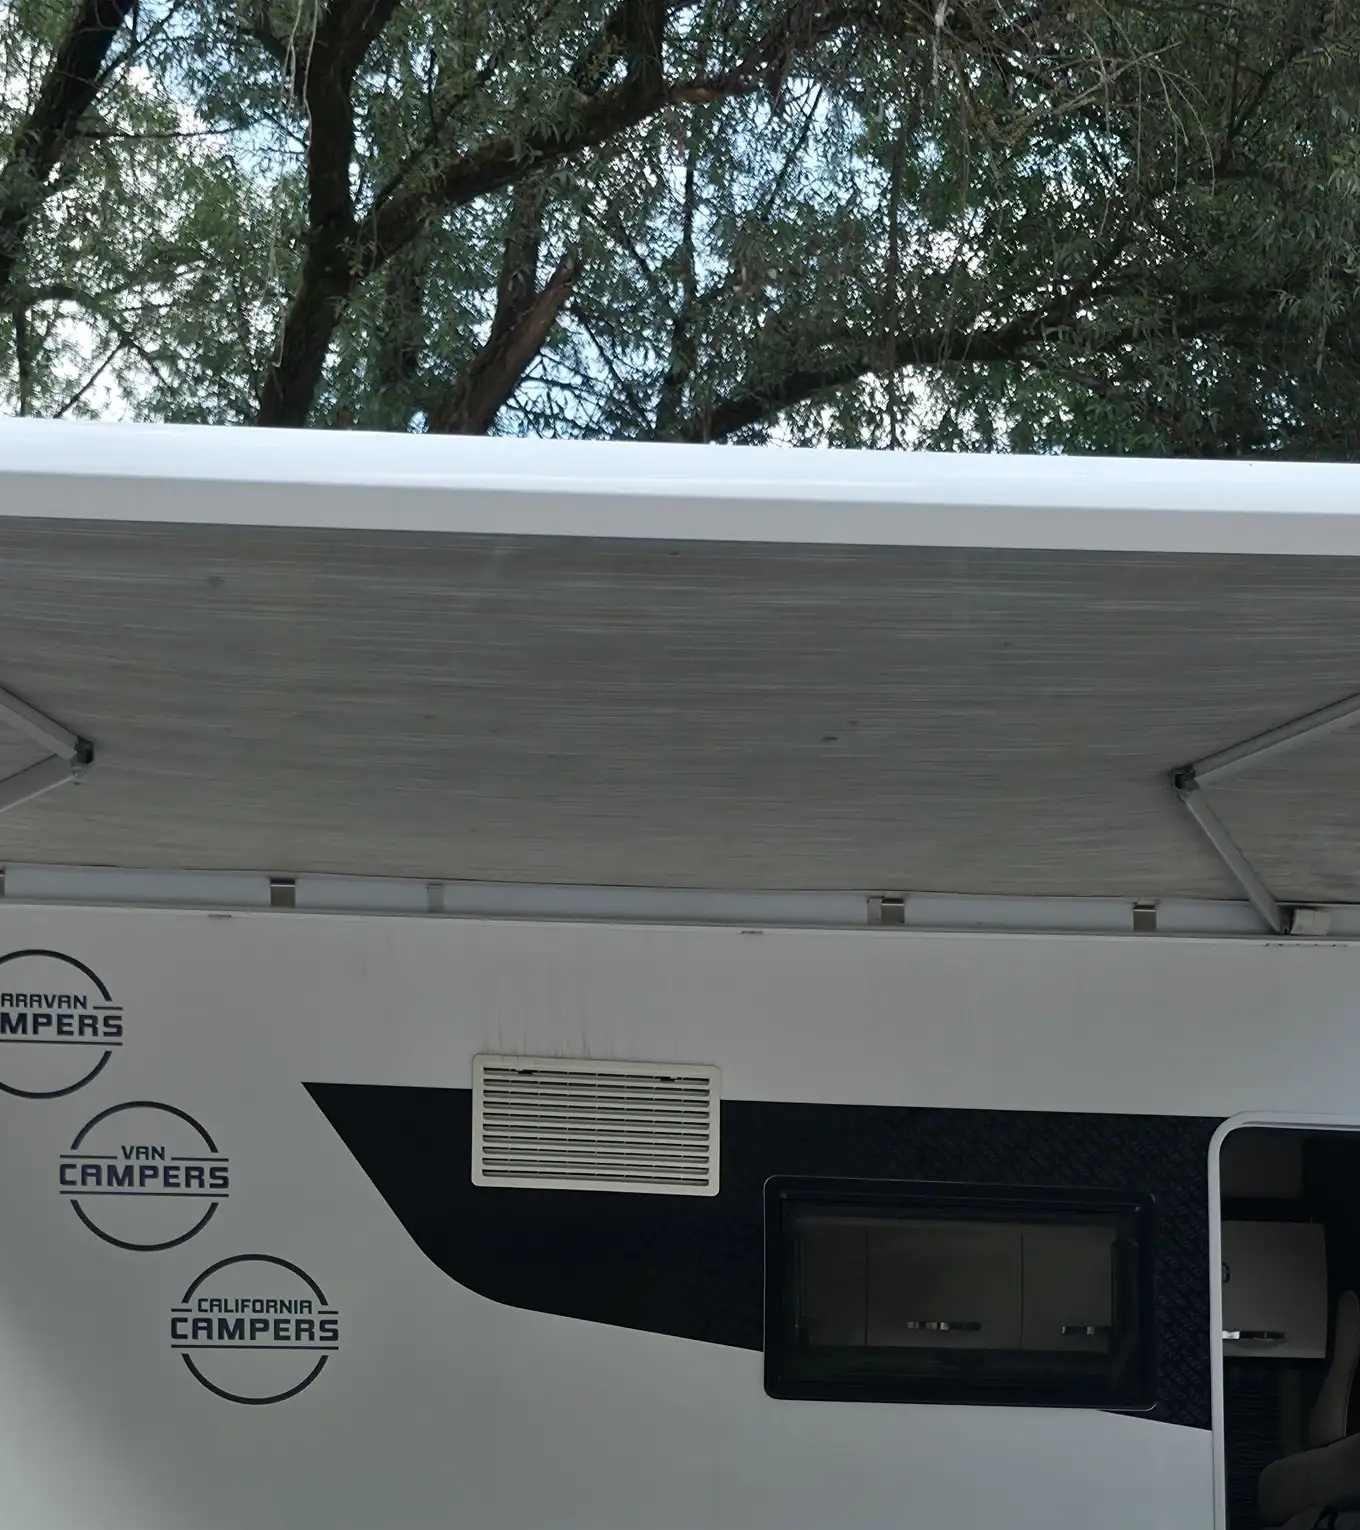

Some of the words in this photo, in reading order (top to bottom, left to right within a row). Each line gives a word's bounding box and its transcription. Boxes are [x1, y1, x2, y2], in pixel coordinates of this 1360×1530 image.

[121, 1145, 165, 1161] VAN
[60, 1164, 229, 1189] CAMPERS
[198, 1299, 312, 1314] CALIFORNIA
[171, 1317, 339, 1342] CAMPERS
